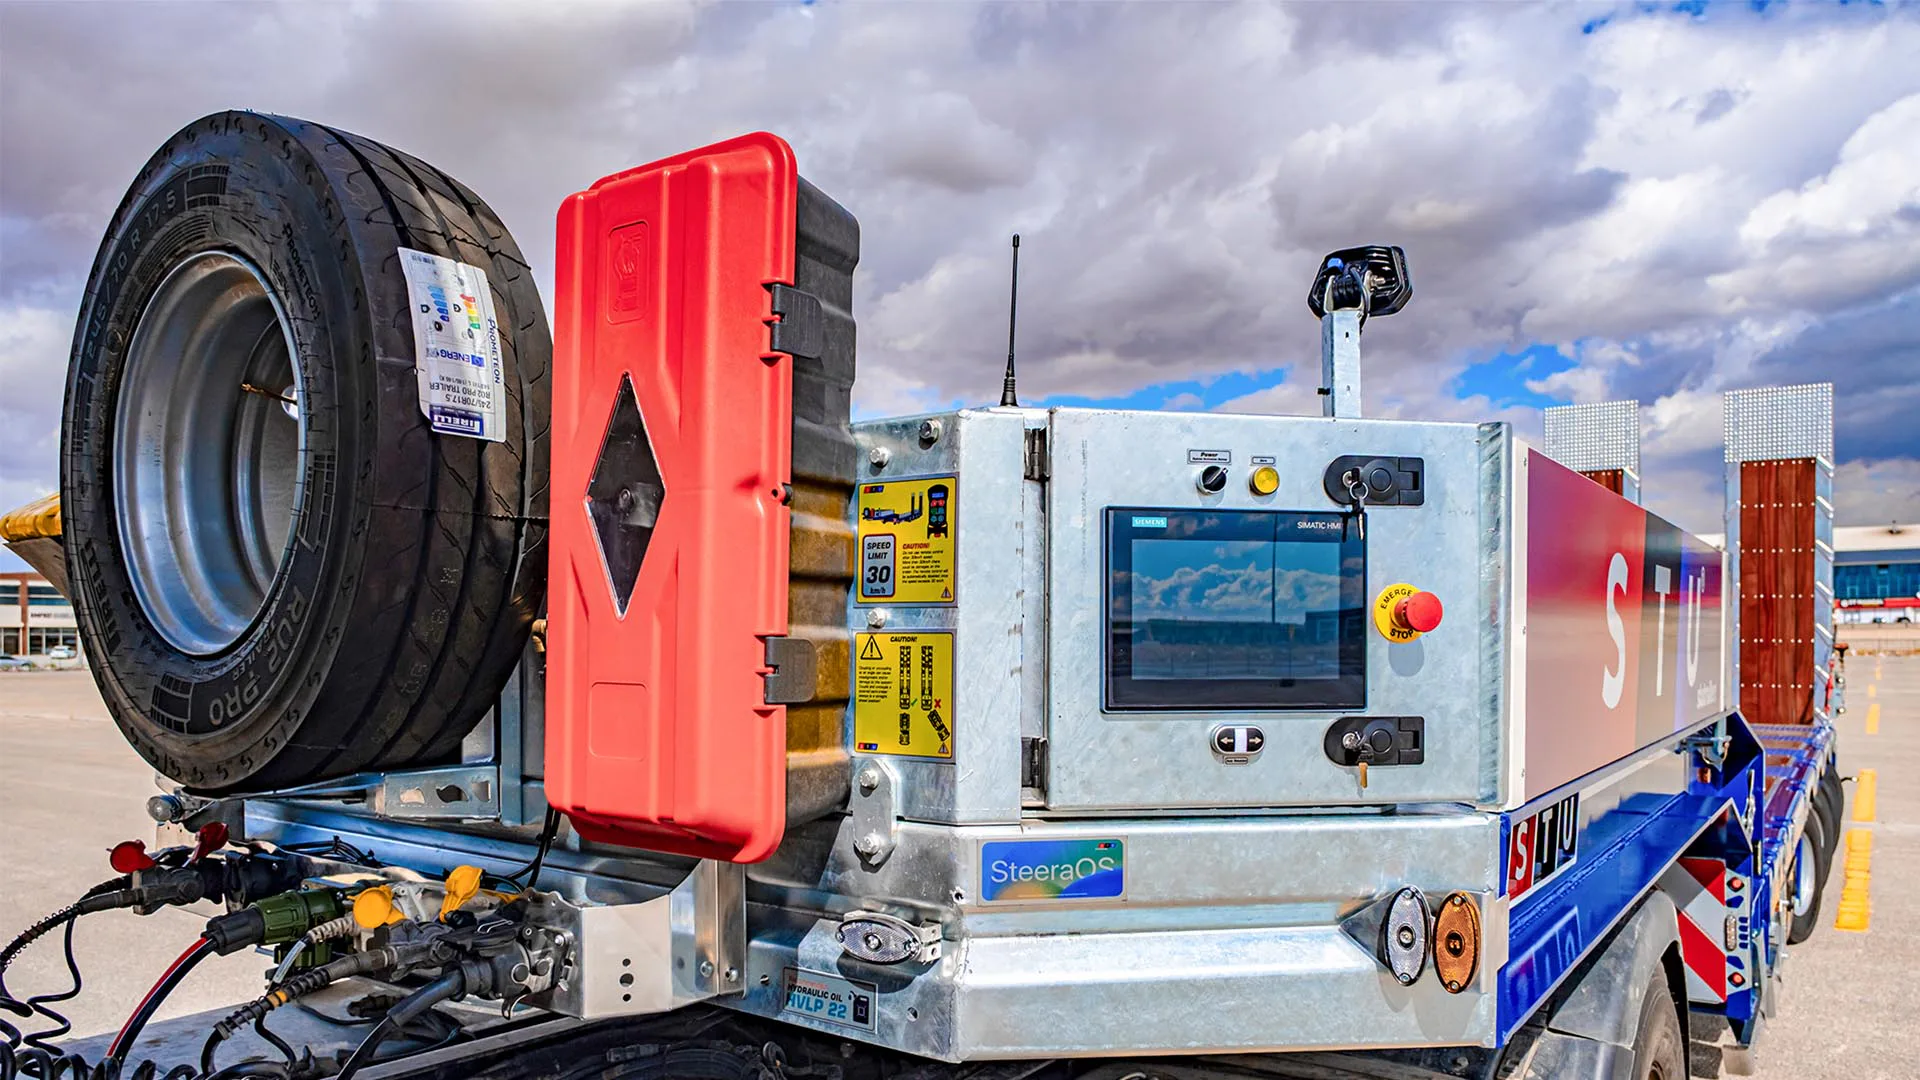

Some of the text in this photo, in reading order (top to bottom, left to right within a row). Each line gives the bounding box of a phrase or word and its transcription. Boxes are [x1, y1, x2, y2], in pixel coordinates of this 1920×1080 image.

[487, 315, 501, 385] PROMETEON
[428, 381, 460, 394] TRAILER
[461, 386, 476, 396] PRO
[444, 393, 492, 409] 245/70R17.5
[432, 414, 481, 433] PIRELLI
[1297, 522, 1326, 530] SIMATIC
[867, 542, 891, 550] SPEED
[902, 542, 930, 550] CAUTION!
[867, 552, 888, 560] LIMIT
[866, 566, 891, 584] 30
[1390, 628, 1414, 639] STOP
[232, 619, 276, 681] TRAILER
[209, 670, 261, 726] PRO
[1515, 795, 1576, 882] STU
[787, 983, 843, 1002] HYDRAULIC OIL
[827, 1002, 847, 1019] 22
